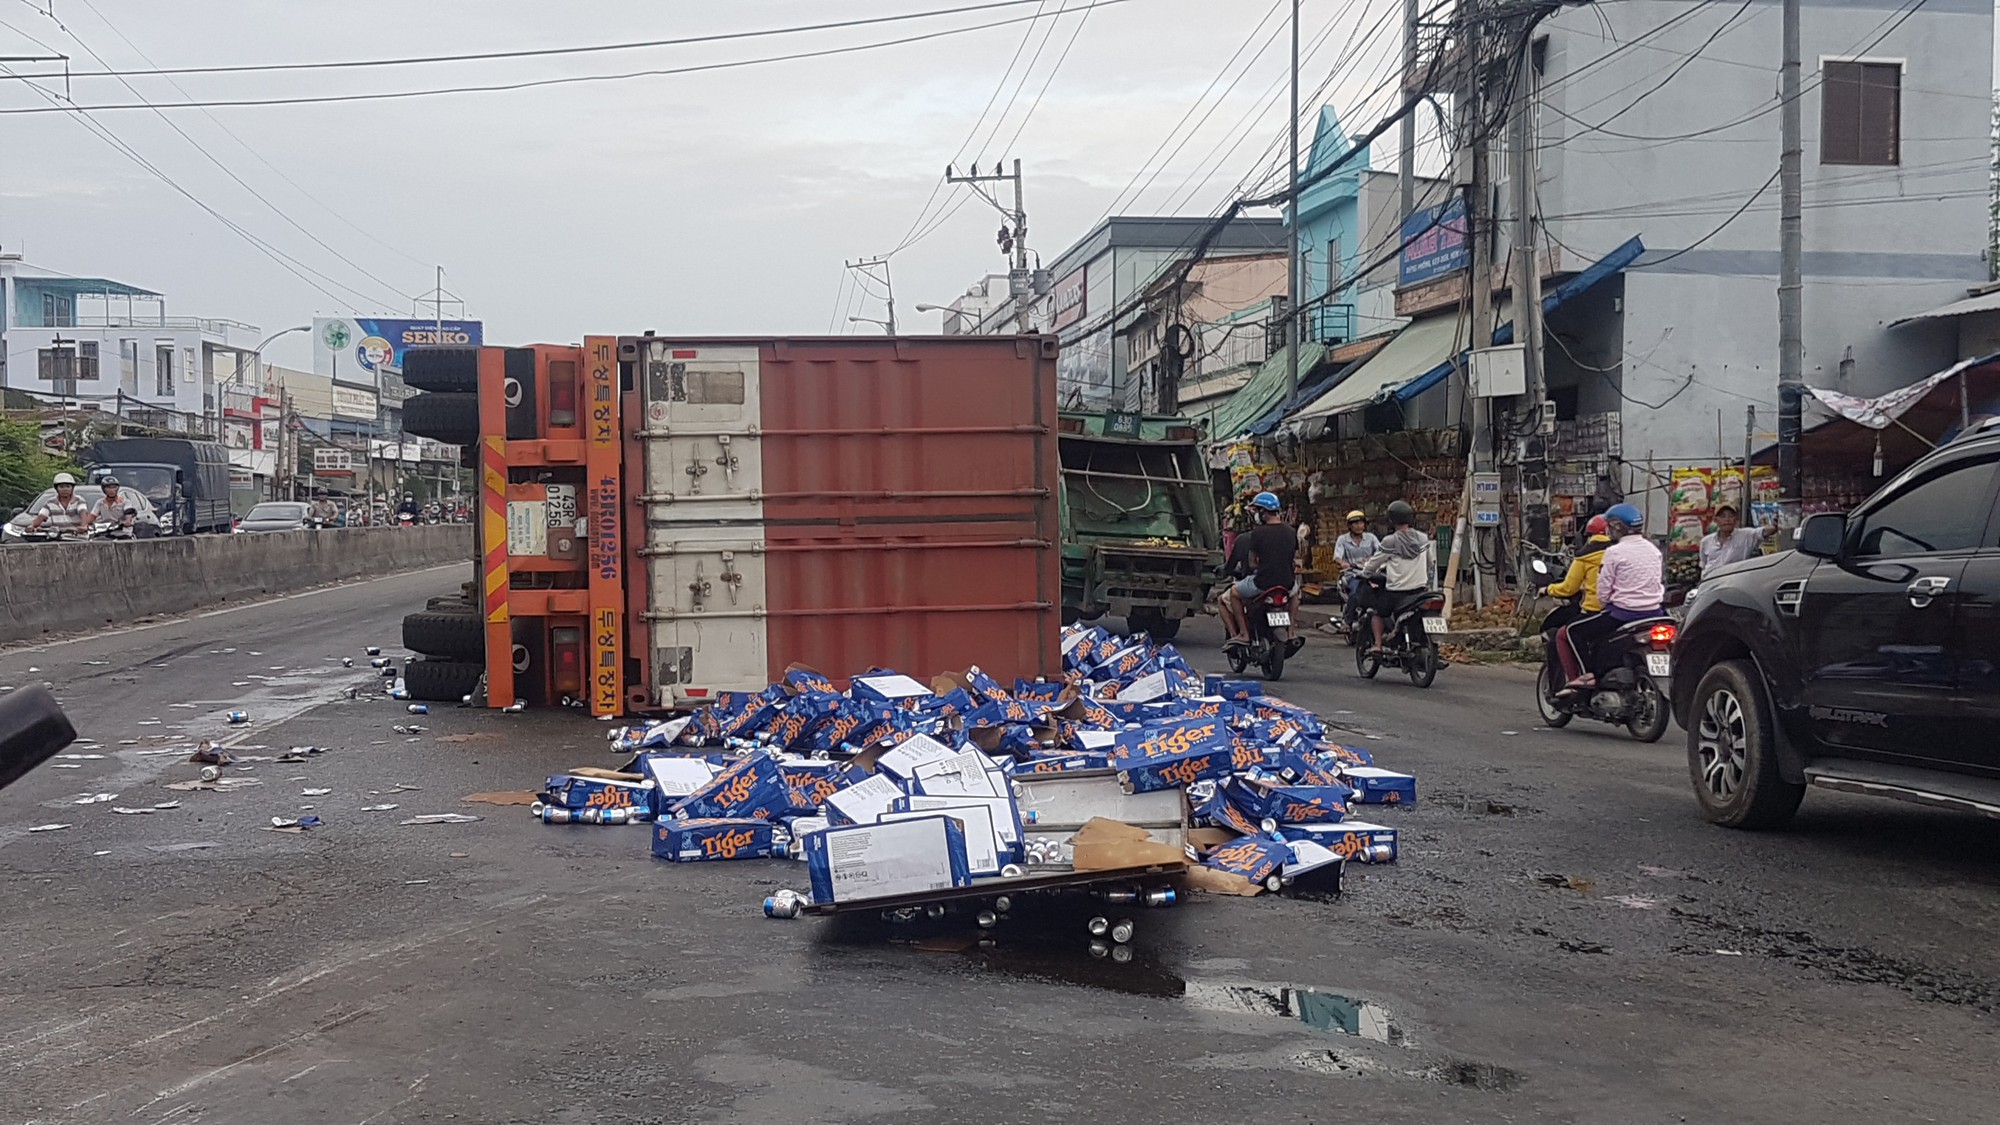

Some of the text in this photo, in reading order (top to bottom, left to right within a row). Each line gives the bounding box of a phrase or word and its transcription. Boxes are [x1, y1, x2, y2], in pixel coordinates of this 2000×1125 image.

[402, 331, 470, 345] SENKO
[592, 344, 611, 444] 두성특장차
[562, 494, 575, 518] 43R
[600, 475, 617, 580] 43R01256
[598, 610, 615, 708] 두성특장차
[829, 714, 859, 746] Tiger
[1137, 723, 1216, 757] Tiger
[1159, 756, 1212, 784] Tiger
[585, 785, 632, 809] Tiger
[713, 767, 759, 808] Tiger
[1284, 803, 1330, 822] Tiger
[701, 828, 755, 859] Tiger
